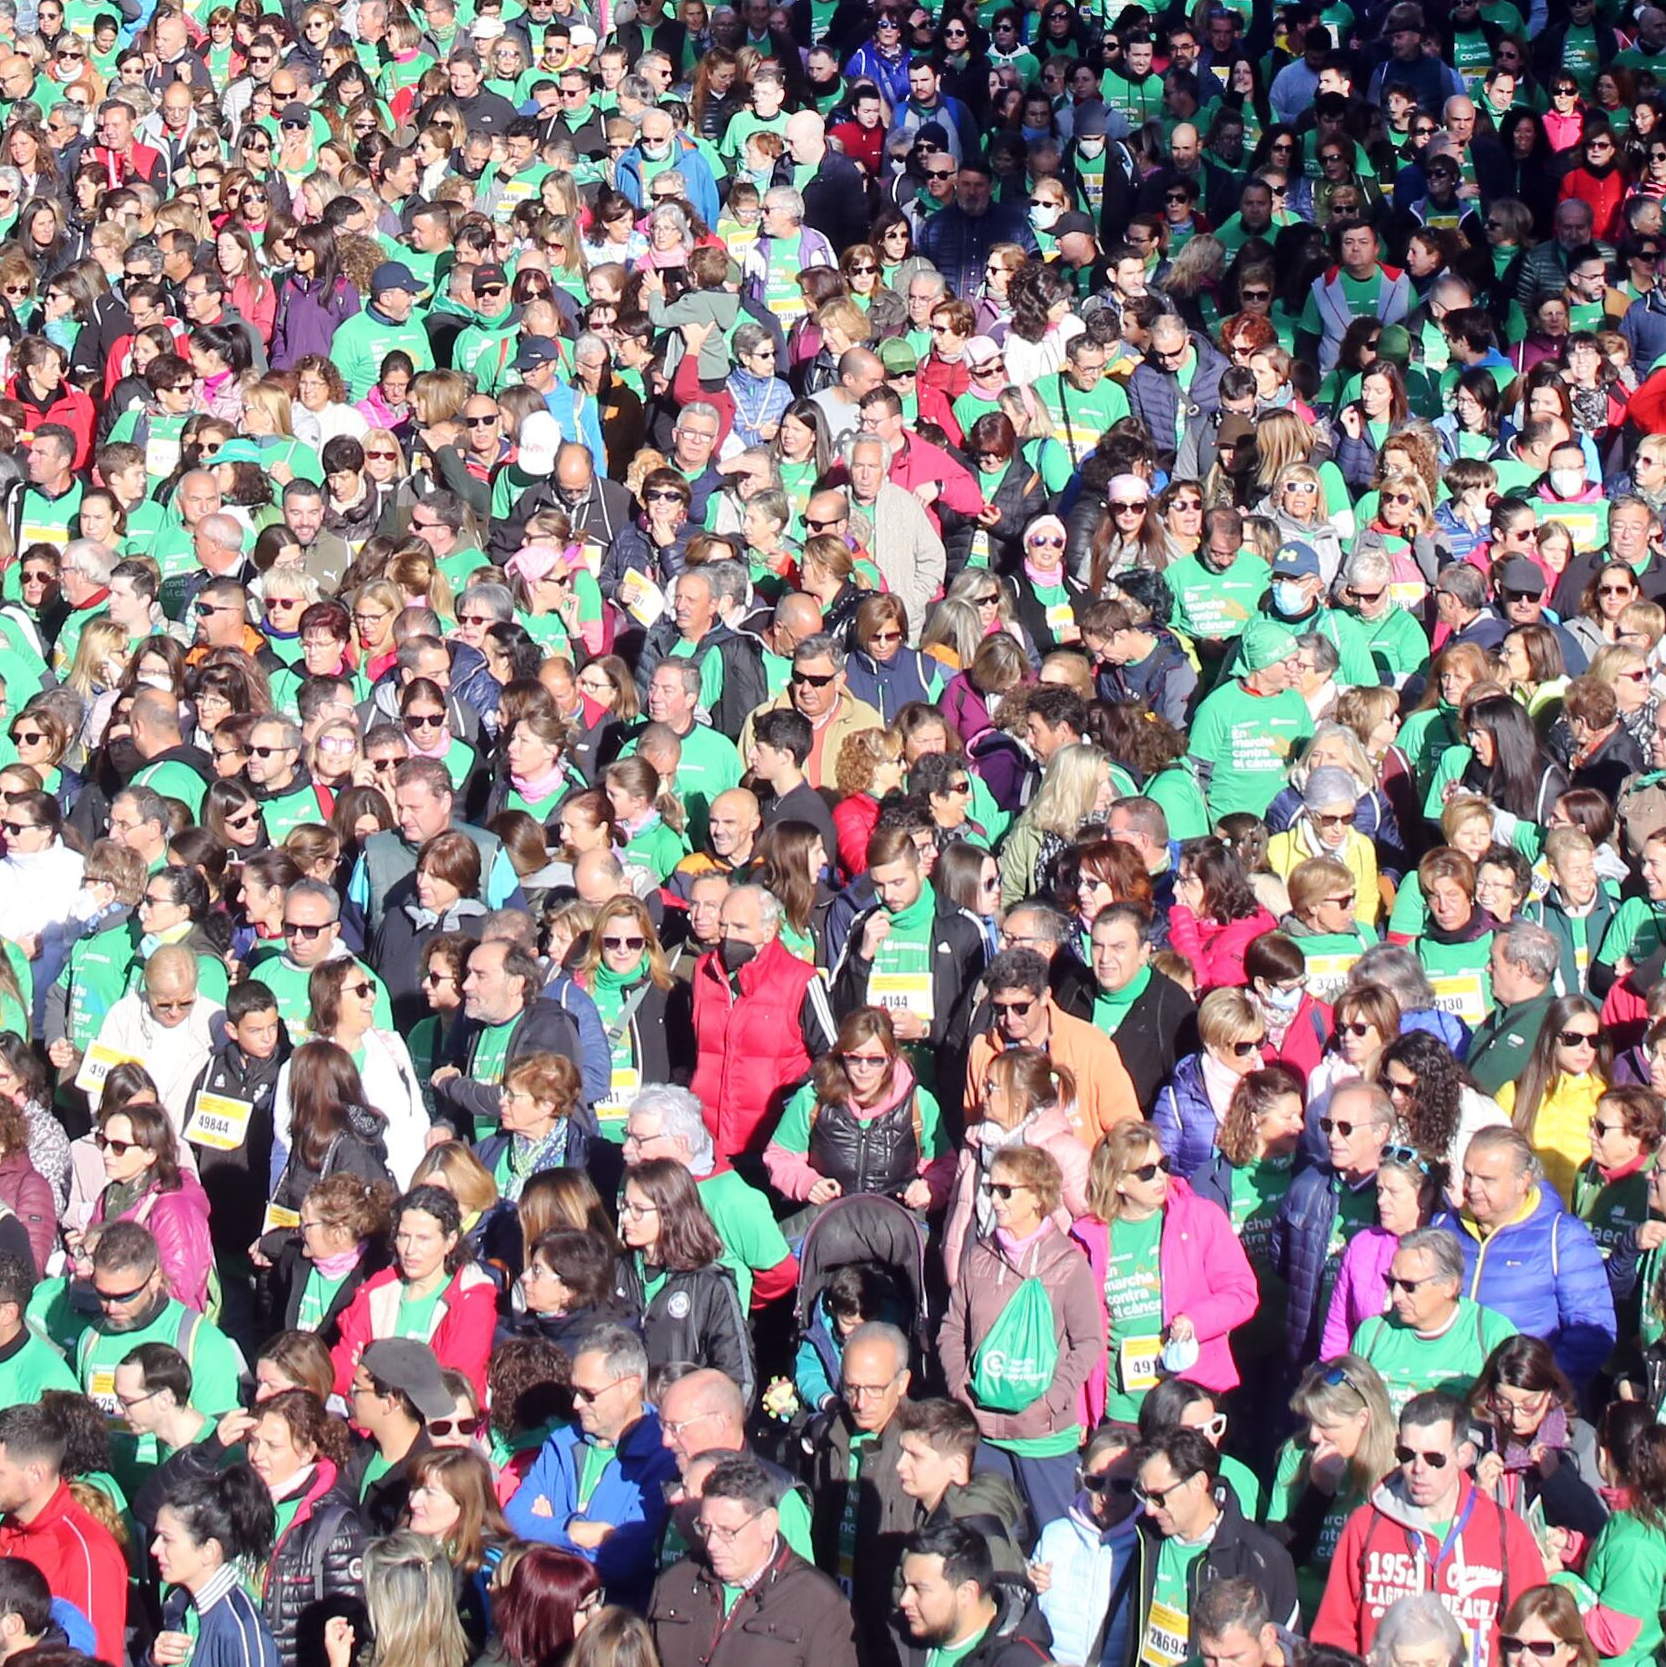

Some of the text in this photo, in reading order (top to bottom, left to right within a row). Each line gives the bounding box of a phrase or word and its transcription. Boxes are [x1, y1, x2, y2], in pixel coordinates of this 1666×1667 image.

[1232, 728, 1246, 738] En
[1232, 748, 1269, 759] contra
[199, 1114, 230, 1134] 49844
[1105, 1274, 1154, 1292] marcha
[1108, 1289, 1149, 1305] contra
[1150, 1627, 1189, 1658] 28694
